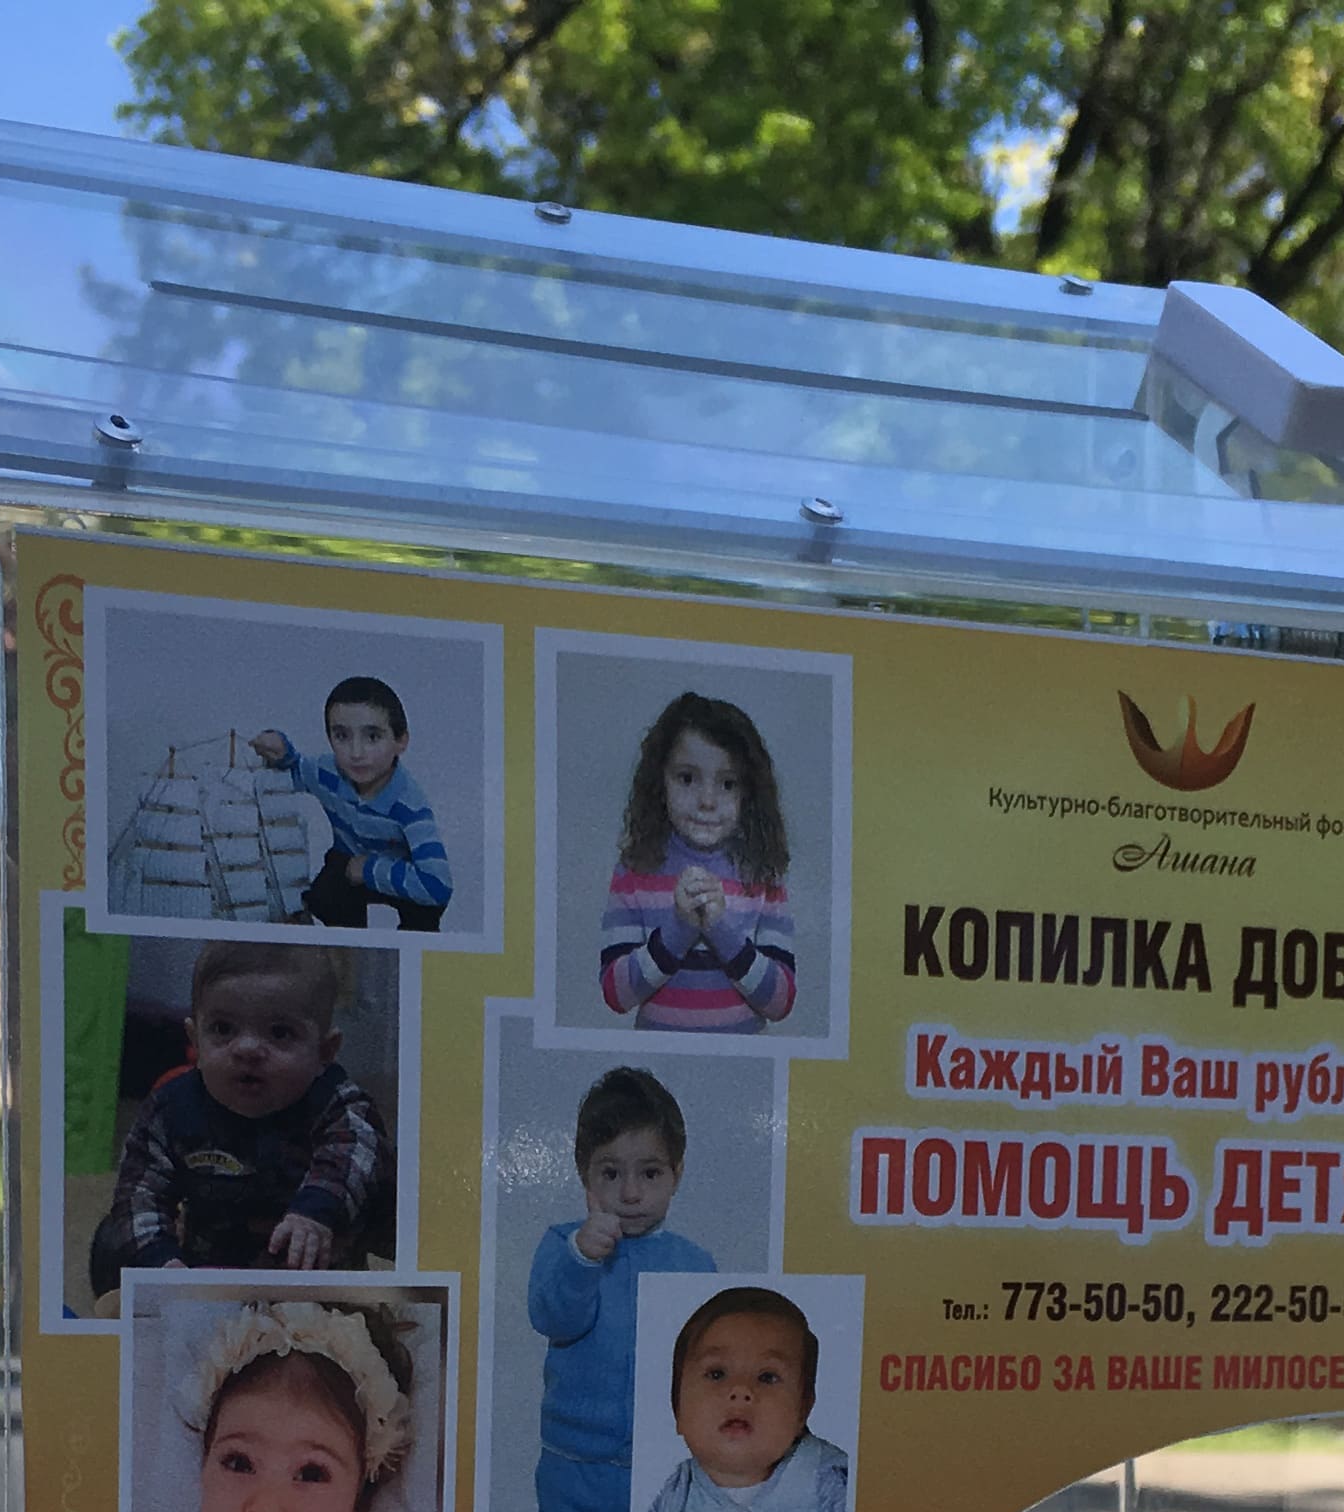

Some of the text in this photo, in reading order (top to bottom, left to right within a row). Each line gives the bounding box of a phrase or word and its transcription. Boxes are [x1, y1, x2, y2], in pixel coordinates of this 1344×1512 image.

[988, 786, 1312, 833] Культурно-благотворительный
[1112, 832, 1258, 878] Ашана
[903, 904, 1213, 994] КОПИЛКА
[915, 1033, 1123, 1100] Каждый
[1140, 1044, 1239, 1100] Ваш
[859, 1137, 1191, 1235] ПОМОЩЬ
[942, 1298, 990, 1321] Тел.:
[1000, 1281, 1196, 1328] 773-50-50,
[878, 1353, 1042, 1393] СПАСИБО
[1052, 1354, 1096, 1392] ЗА
[1106, 1354, 1203, 1392] ВАШЕ
